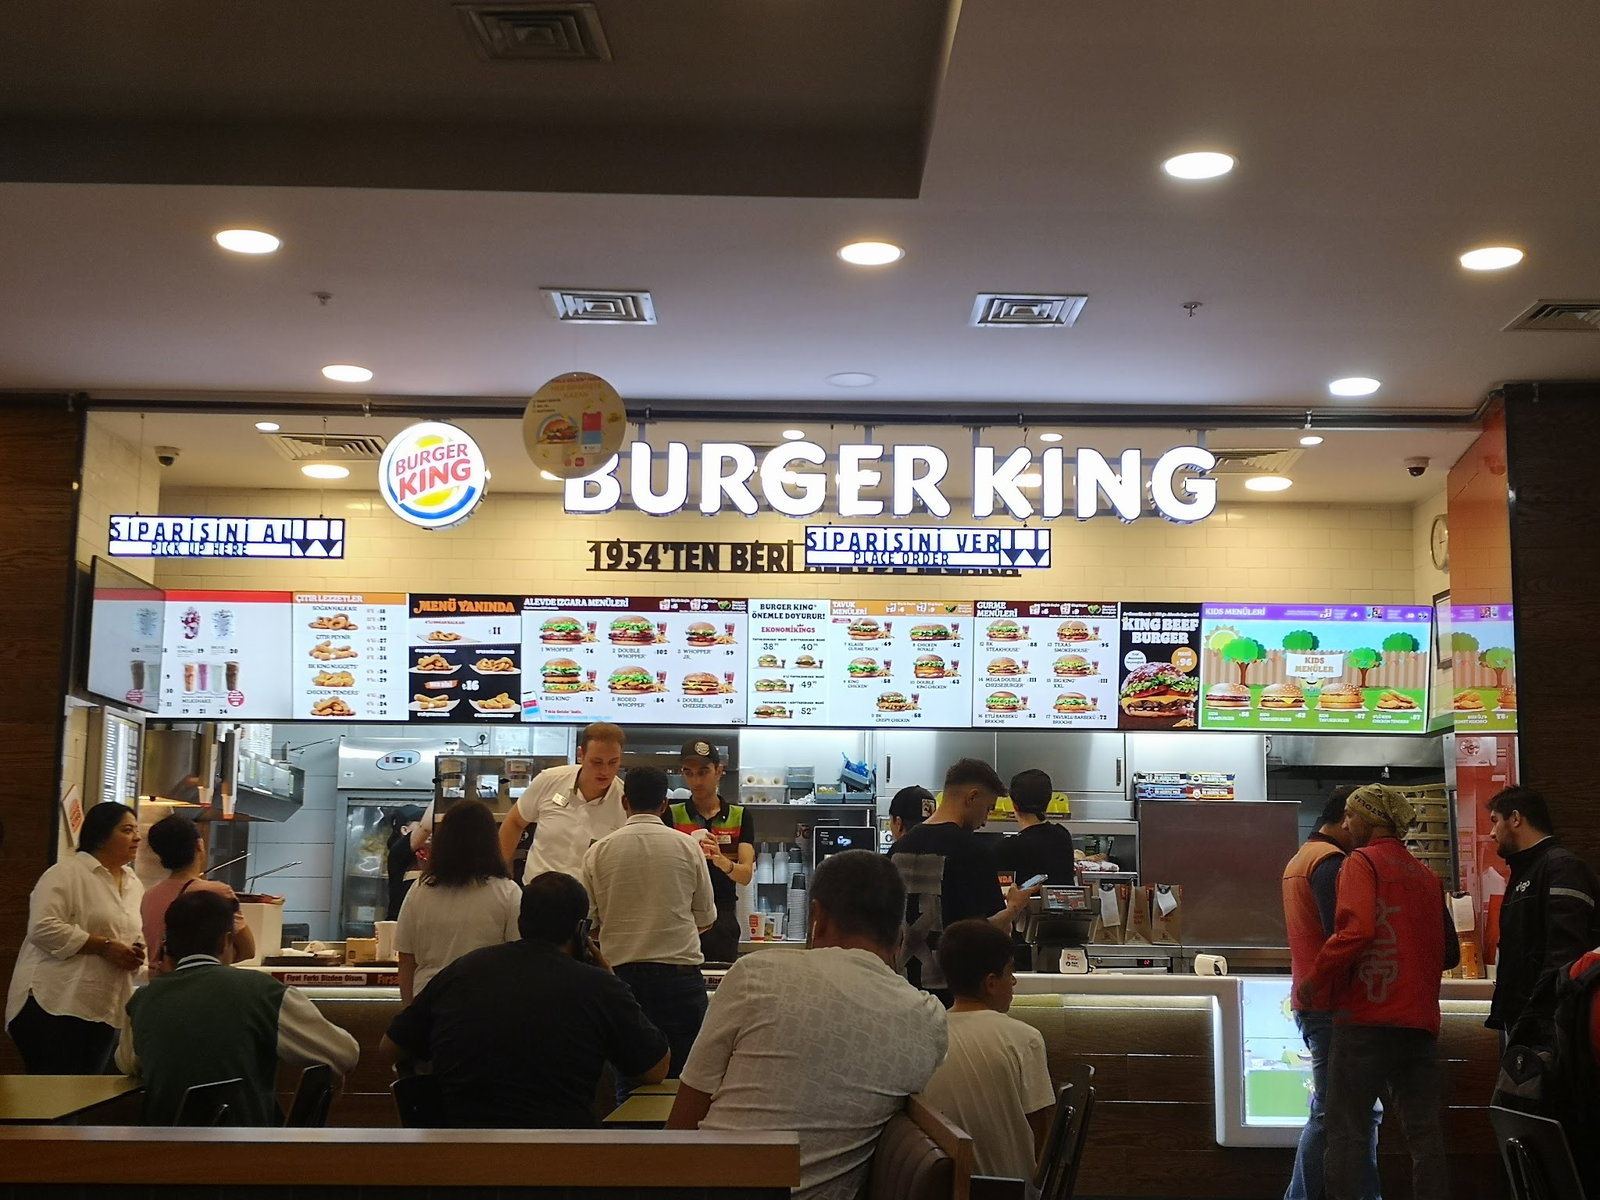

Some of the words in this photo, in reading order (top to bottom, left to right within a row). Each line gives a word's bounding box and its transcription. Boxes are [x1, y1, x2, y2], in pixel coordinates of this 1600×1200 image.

[395, 443, 468, 477] BURGER
[399, 458, 471, 501] KING
[563, 441, 952, 519] BURGER
[972, 445, 1218, 522] KING
[263, 523, 292, 542] AL
[151, 542, 180, 556] PICK
[188, 543, 206, 556] UP
[213, 543, 248, 556] HERE
[956, 533, 1000, 553] VER
[589, 541, 720, 571] 1954'TEN
[854, 551, 894, 566] PLACE
[902, 552, 949, 566] ORDER
[414, 597, 457, 614] MENÜ
[458, 599, 515, 613] YANINDA
[524, 597, 556, 606] ALEVDE
[557, 598, 587, 607] IZGARA
[588, 597, 629, 607] MENÜLERİ
[752, 610, 783, 619] ÖNEMLE
[832, 607, 867, 615] MENÜLERİ
[976, 608, 1018, 617] MENÜLERİ
[1225, 607, 1266, 616] MENÜLERİ
[1122, 618, 1161, 631] KING
[1162, 618, 1199, 631] BEEF
[1131, 632, 1190, 644] BURGER
[1305, 656, 1325, 664] KIDS
[1295, 664, 1334, 673] MENÜLER
